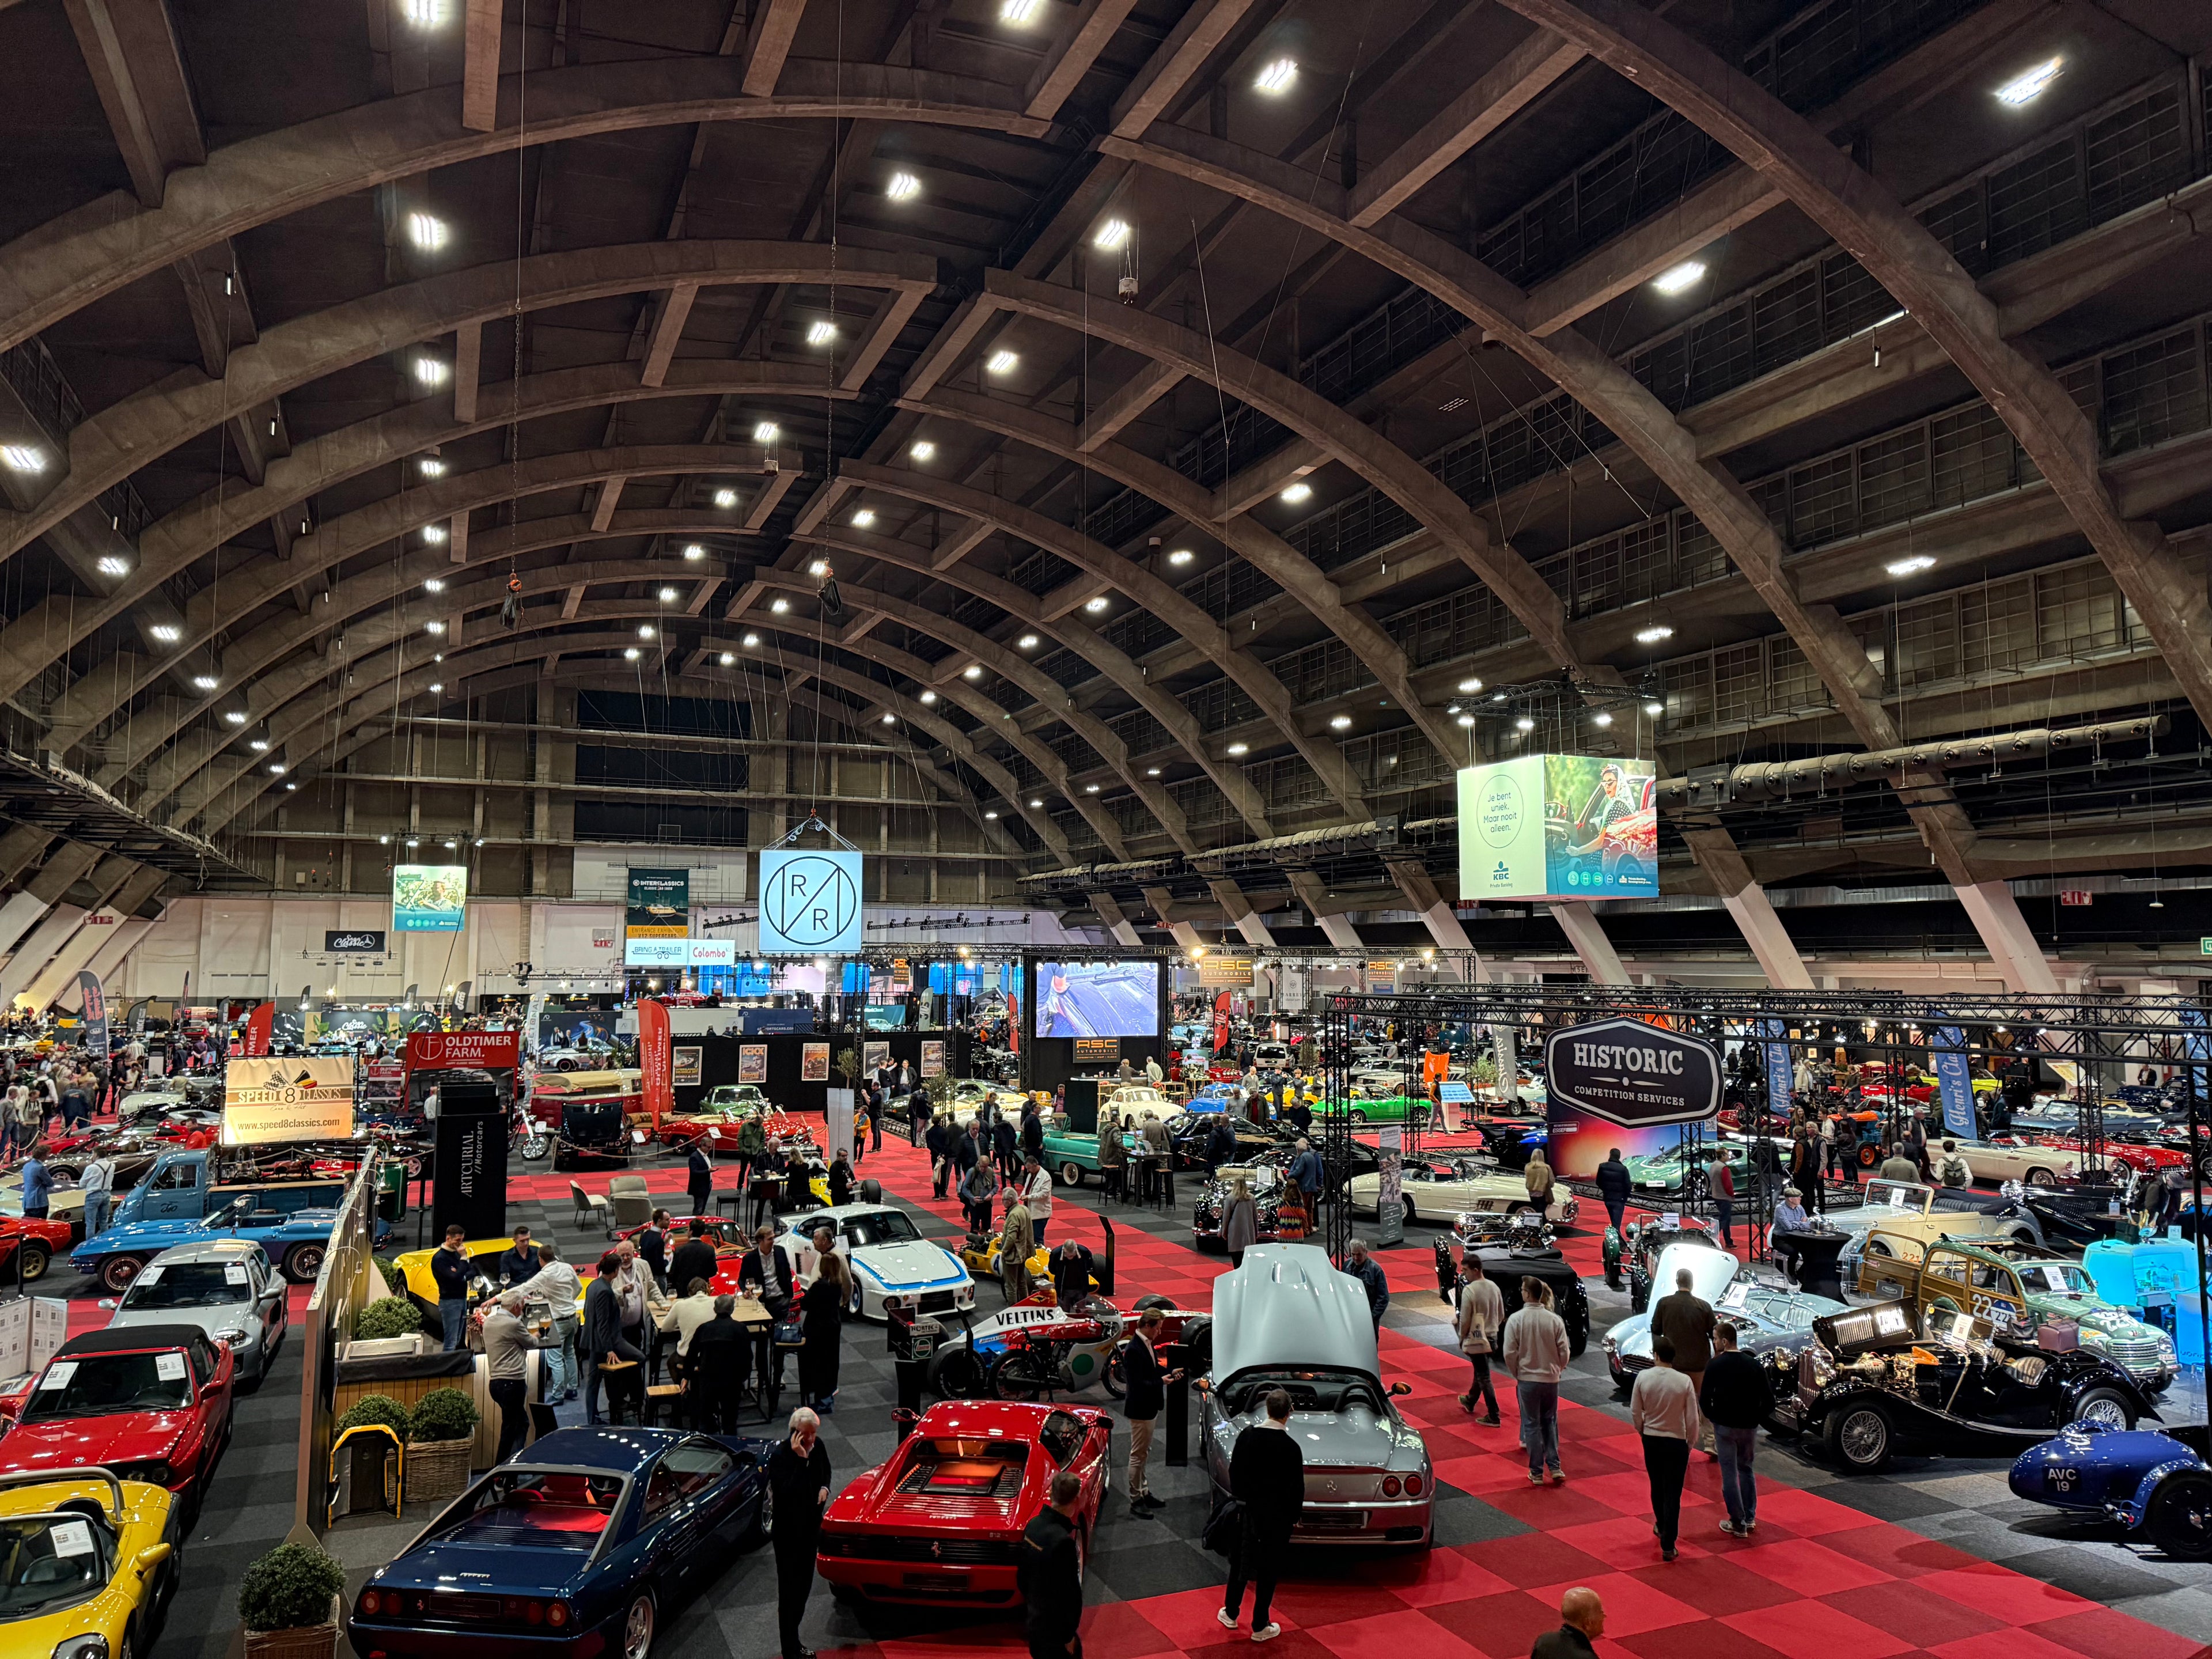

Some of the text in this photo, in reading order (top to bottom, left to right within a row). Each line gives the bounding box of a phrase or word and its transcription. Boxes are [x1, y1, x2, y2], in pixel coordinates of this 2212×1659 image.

[1497, 792, 1511, 801] bent
[1491, 802, 1509, 812] uniek.
[1483, 812, 1517, 823] Maar nooit
[1490, 824, 1511, 833] alleen.
[1493, 873, 1509, 881] KBC
[791, 874, 807, 897] R
[813, 908, 828, 931] R
[693, 946, 726, 958] Colombo
[1203, 960, 1251, 970] RSC
[1368, 961, 1394, 970] RSC
[445, 1036, 512, 1047] OLDTIMER
[1077, 1040, 1117, 1048] RSC
[446, 1048, 485, 1058] FARM.
[1574, 1043, 1683, 1075] HISTORIC
[238, 1088, 341, 1103] SPEED 8 CLASSICS
[1574, 1085, 1685, 1107] COMPETITION SERVICES
[1948, 1080, 1969, 1126] Henri's
[238, 1119, 340, 1131] www.speed8classics.com
[461, 1131, 474, 1198] ARTCURIAL
[1902, 1252, 1919, 1263] 221
[996, 1309, 1054, 1325] VELTINS
[2048, 1468, 2077, 1480] AVC
[2056, 1481, 2070, 1491] 19
